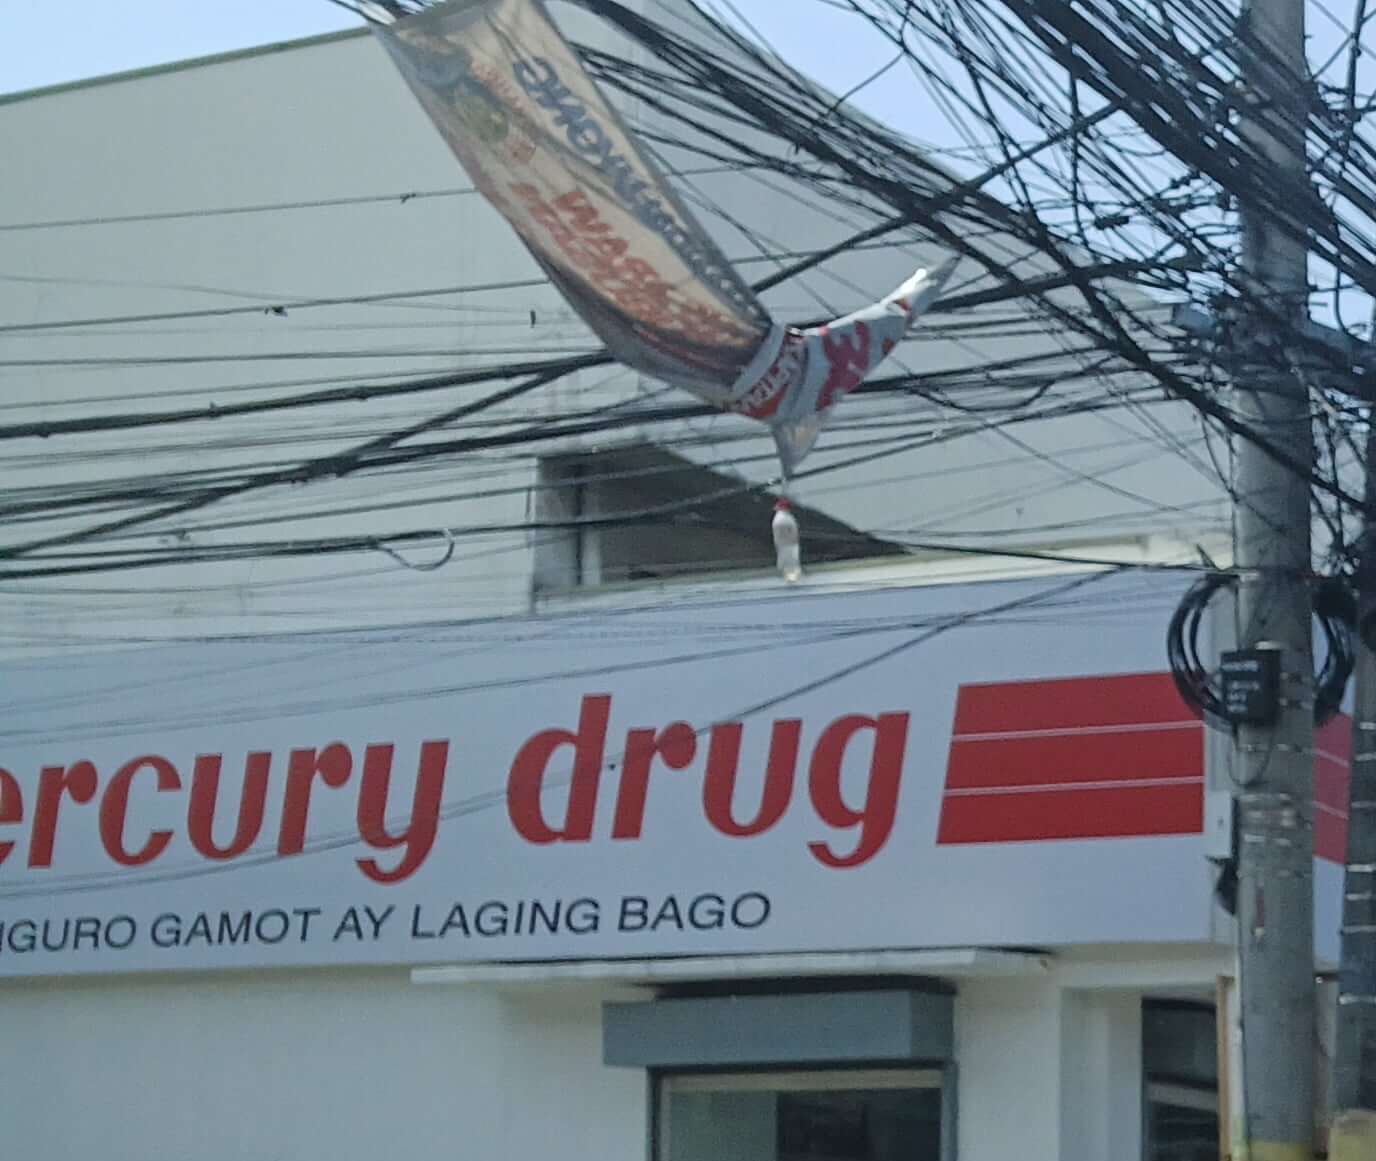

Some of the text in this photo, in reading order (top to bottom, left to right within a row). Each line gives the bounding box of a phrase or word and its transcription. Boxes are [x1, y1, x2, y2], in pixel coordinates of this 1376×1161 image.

[0, 693, 912, 884] rcury drug
[150, 908, 322, 948] GAMOT
[333, 905, 392, 942] AY
[411, 899, 602, 939] LAGING
[618, 891, 772, 933] BAGO
